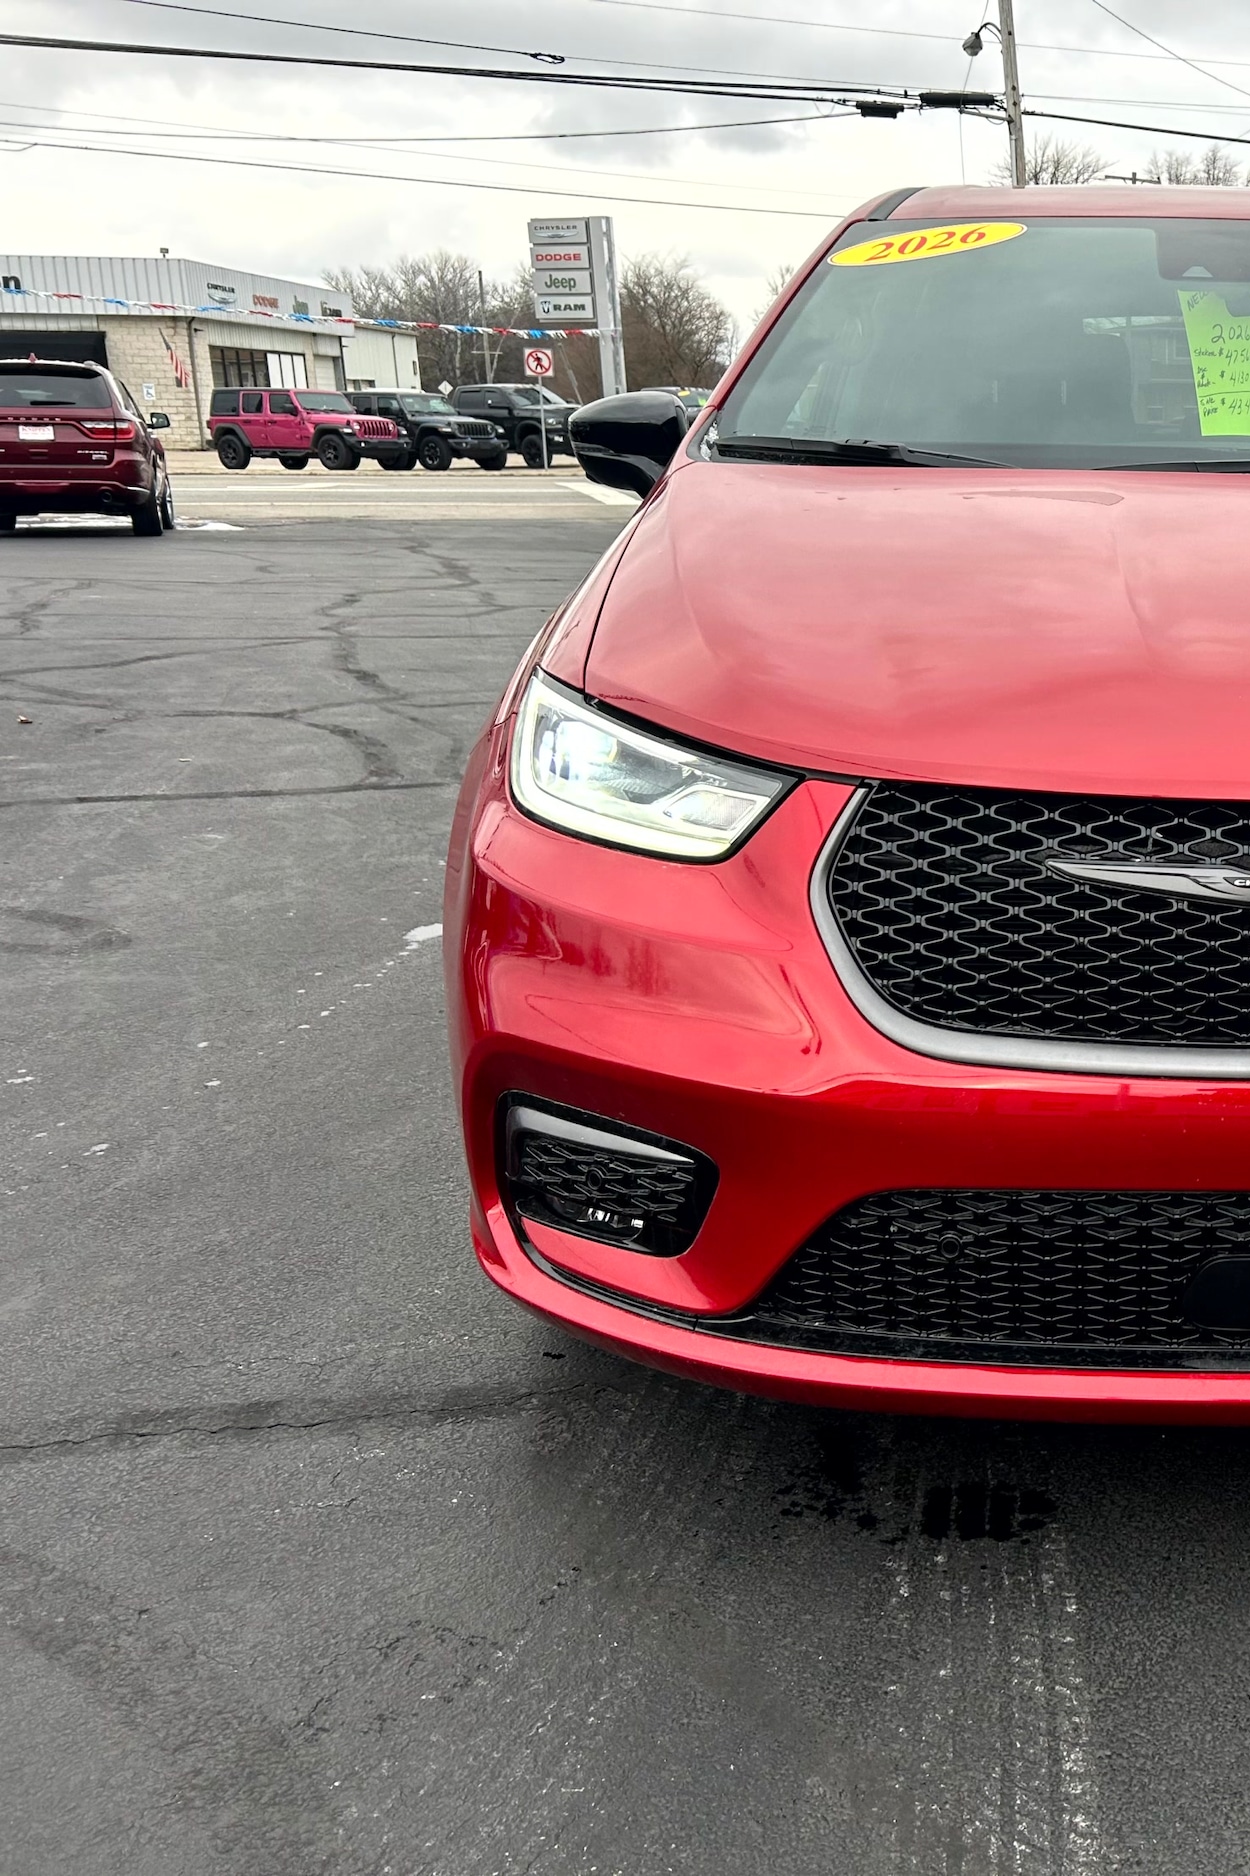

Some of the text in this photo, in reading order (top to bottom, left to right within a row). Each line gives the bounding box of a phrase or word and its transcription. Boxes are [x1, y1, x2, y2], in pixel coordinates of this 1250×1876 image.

[864, 225, 991, 262] 2026
[535, 253, 582, 262] DODGE
[544, 273, 577, 291] Jeep
[1211, 323, 1250, 344] 2026
